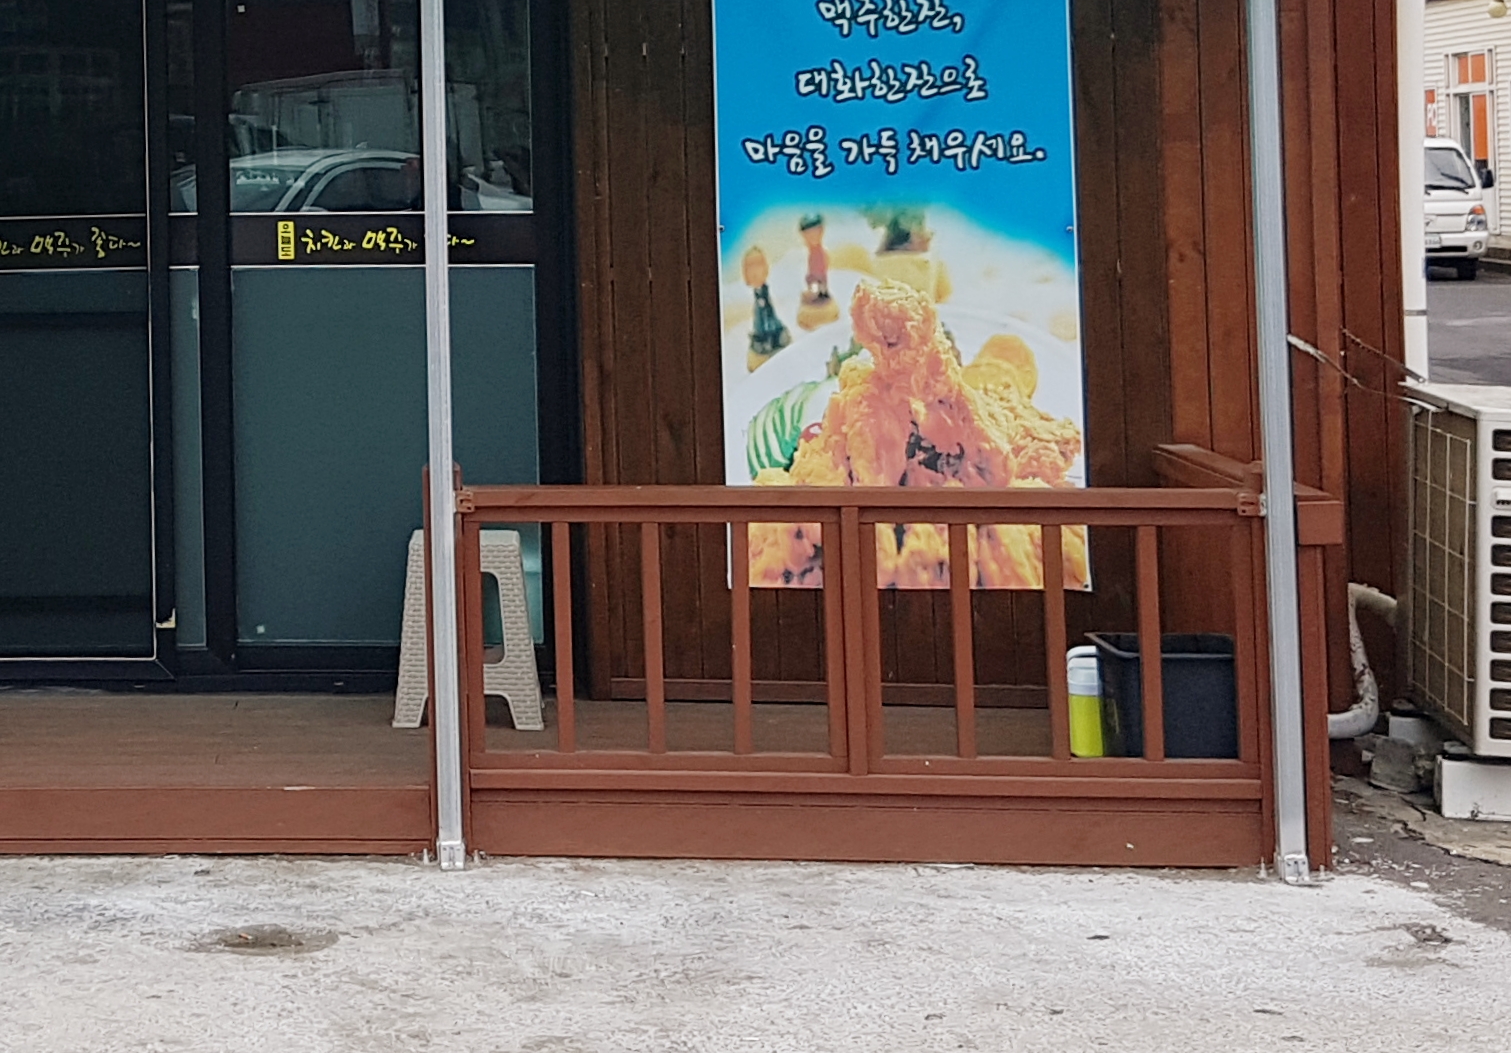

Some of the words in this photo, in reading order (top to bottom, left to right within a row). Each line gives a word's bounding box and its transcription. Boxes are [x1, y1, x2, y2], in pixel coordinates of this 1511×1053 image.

[798, 57, 987, 101] 대화한잔으로
[744, 127, 832, 177] 마음을
[842, 129, 899, 173] 가득
[909, 132, 1046, 169] 채우세요.
[30, 231, 85, 258] 맥주가
[301, 228, 356, 254] 치킨과
[361, 227, 418, 254] 맥주가
